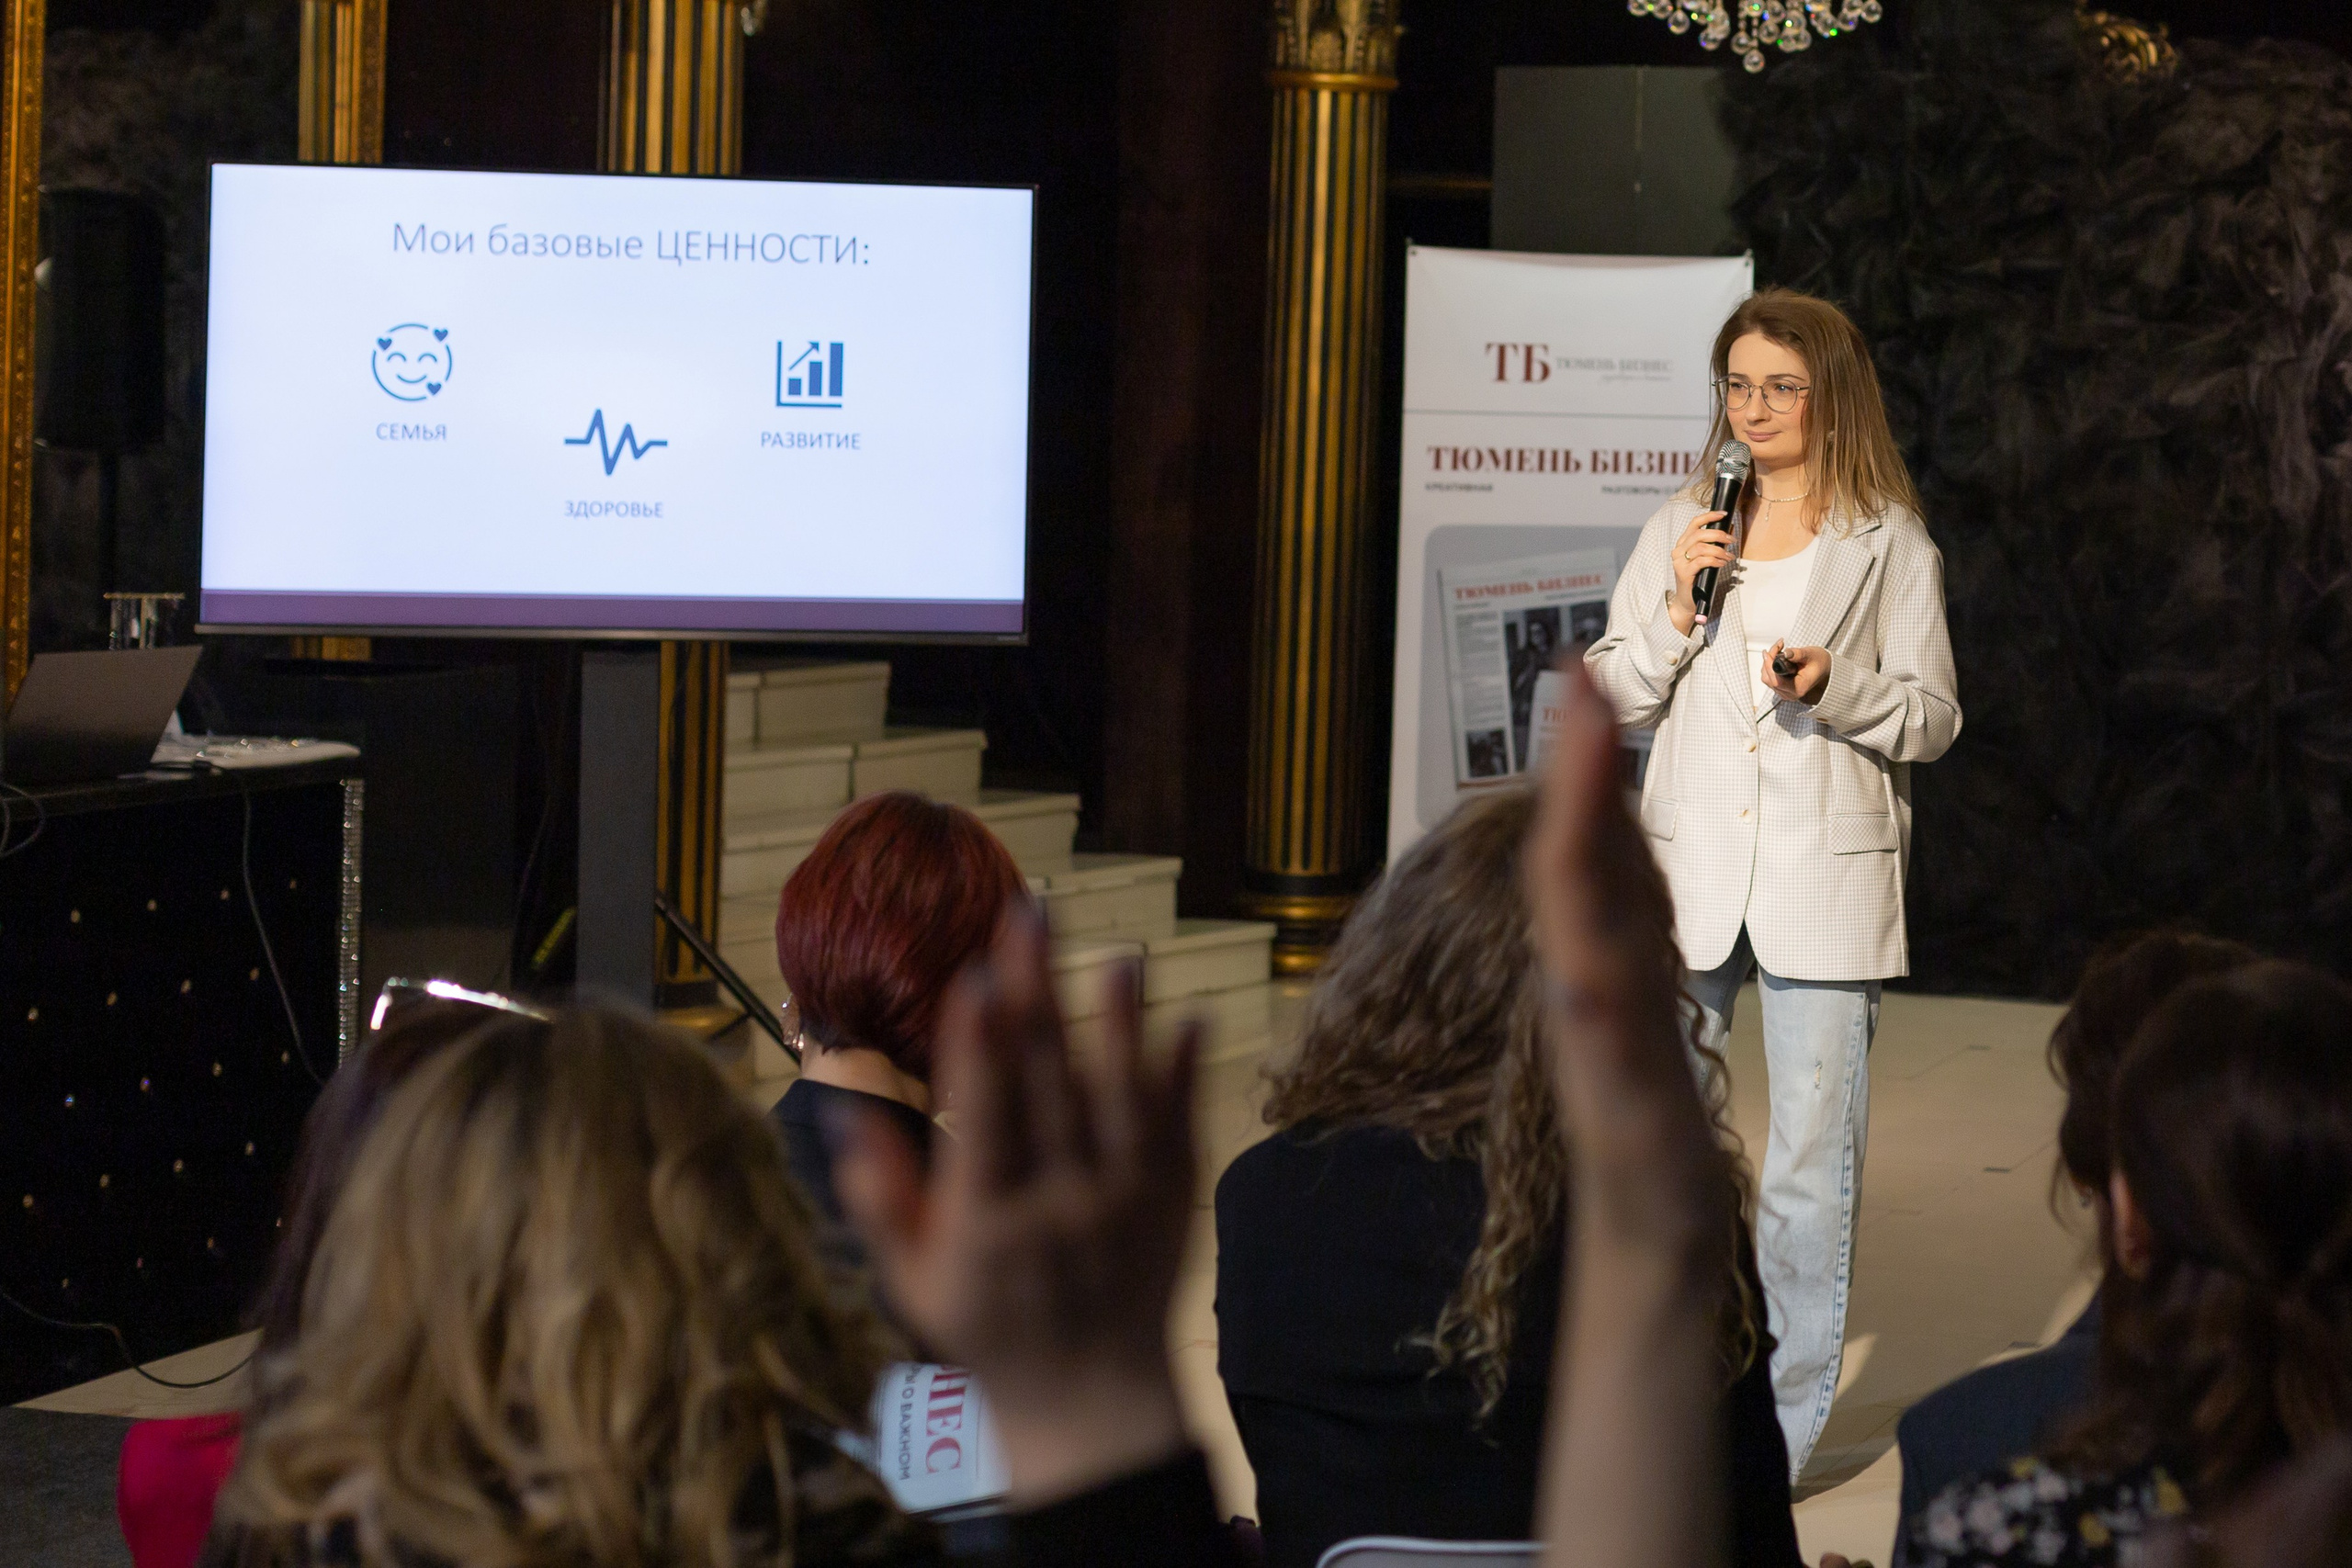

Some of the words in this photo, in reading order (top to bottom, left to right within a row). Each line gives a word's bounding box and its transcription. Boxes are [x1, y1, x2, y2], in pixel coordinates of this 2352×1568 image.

[392, 221, 474, 254] Мои
[487, 222, 644, 261] базовые
[657, 229, 870, 267] ЦЕННОСТИ:
[1486, 343, 1551, 383] ТБ
[376, 422, 447, 442] СЕМЬЯ
[761, 431, 861, 451] РАЗВИТИЕ
[1427, 446, 1582, 474] ТЮМЕНЬ
[1590, 449, 1699, 476] БИЗНЕ
[564, 500, 663, 520] ЗДОРОВЬЕ
[926, 1369, 967, 1474] НЕС
[898, 1403, 913, 1481] ВАЖНОМ
